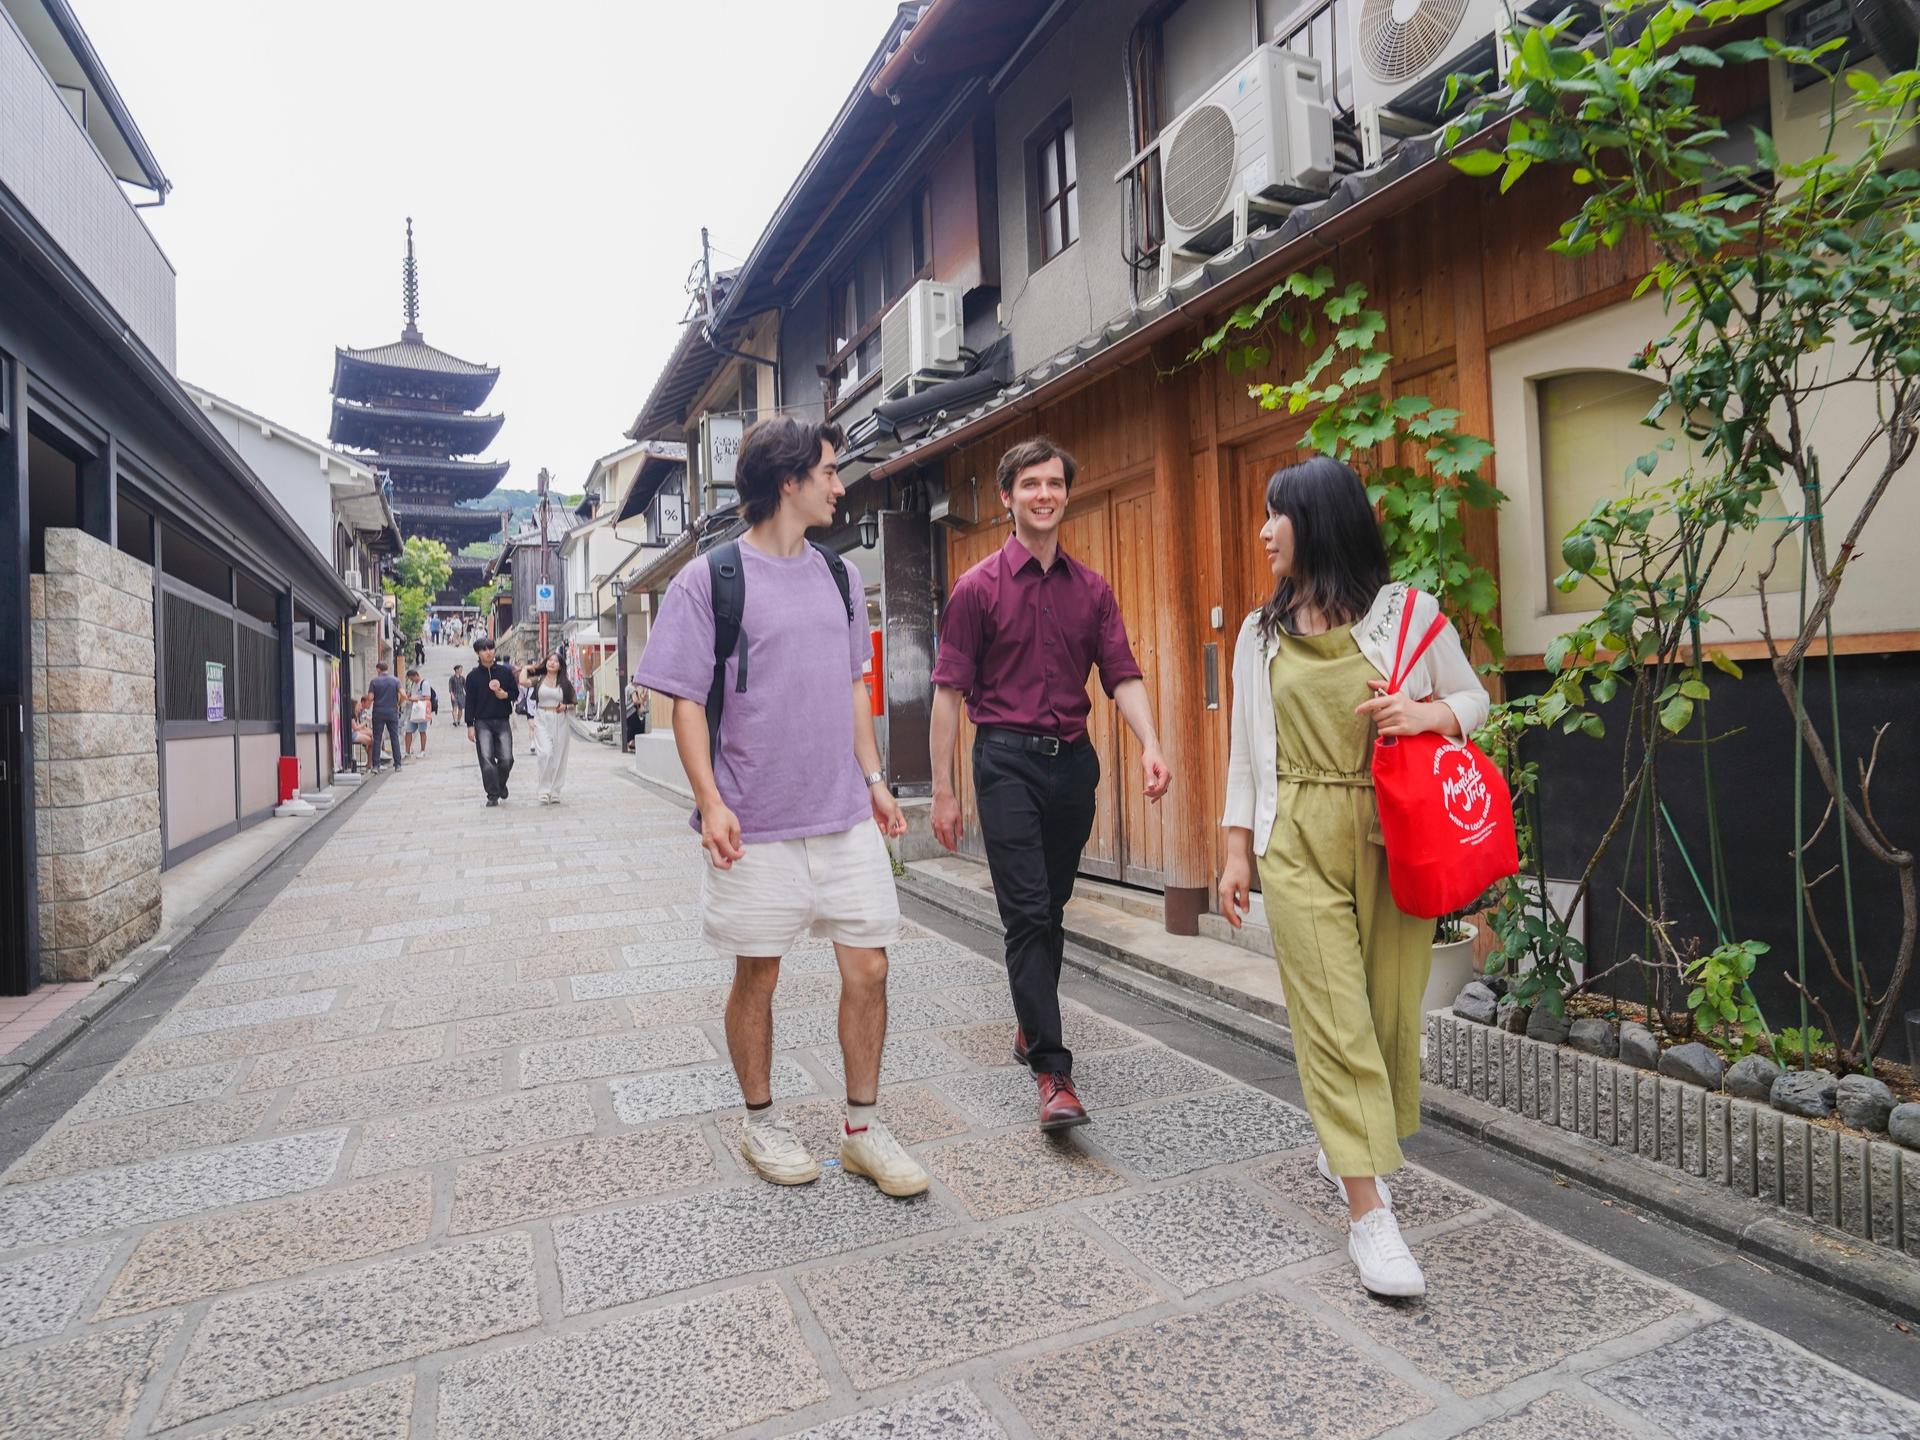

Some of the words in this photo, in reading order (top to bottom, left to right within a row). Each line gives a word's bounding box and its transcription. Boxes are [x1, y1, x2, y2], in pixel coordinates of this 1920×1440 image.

[664, 509, 678, 521] %
[1442, 758, 1480, 812] Magical
[1466, 773, 1486, 804] Trip
[1470, 816, 1485, 831] LOCAL
[1482, 792, 1492, 819] GUIDE
